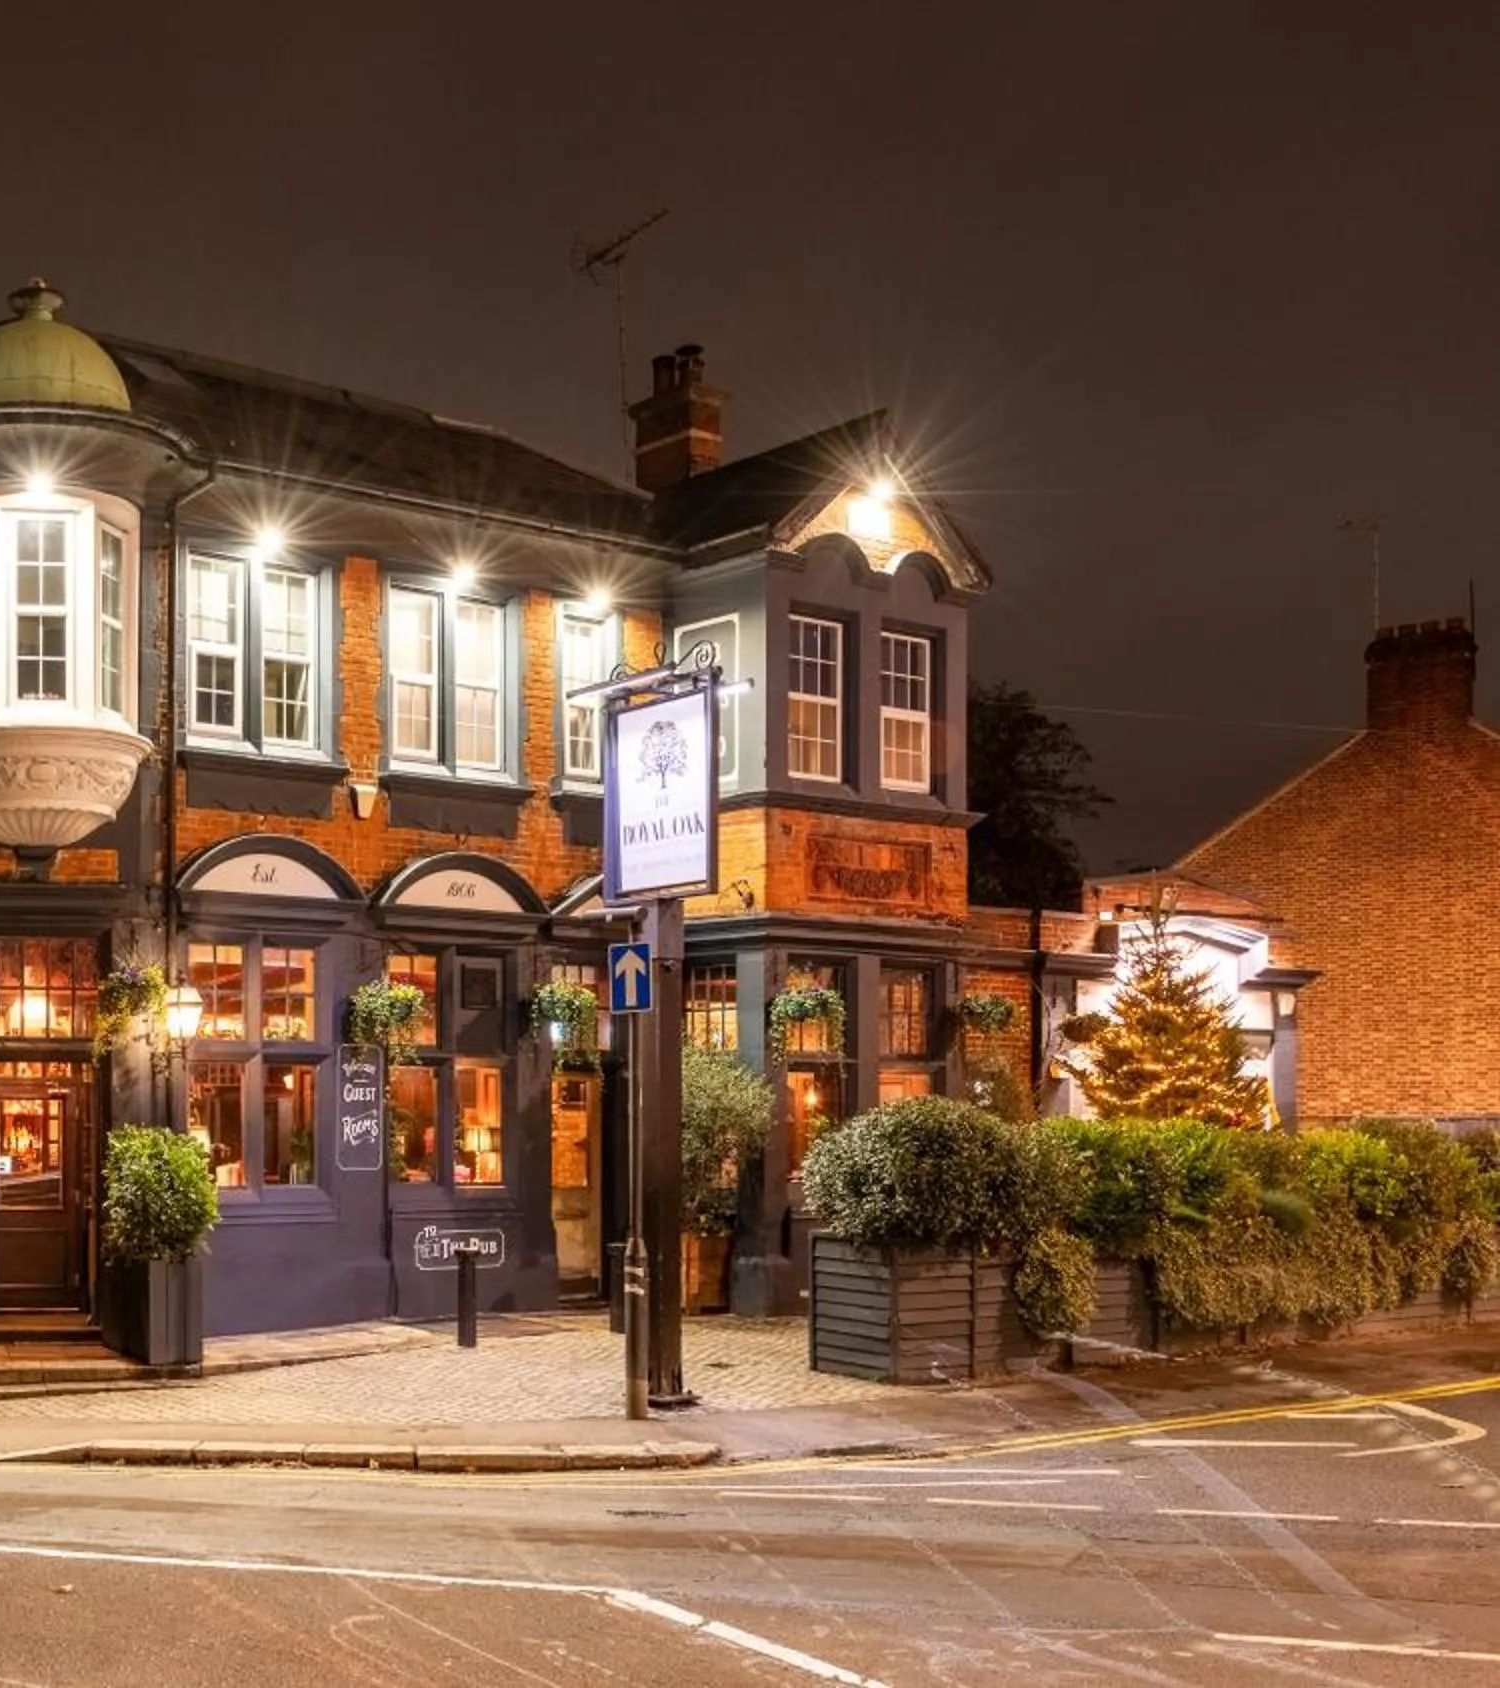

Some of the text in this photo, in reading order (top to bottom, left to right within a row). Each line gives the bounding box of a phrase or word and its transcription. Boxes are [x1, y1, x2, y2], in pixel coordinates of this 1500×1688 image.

[673, 811, 705, 835] OAK
[343, 1083, 377, 1102] GUEST
[342, 1115, 378, 1142] ROOMS
